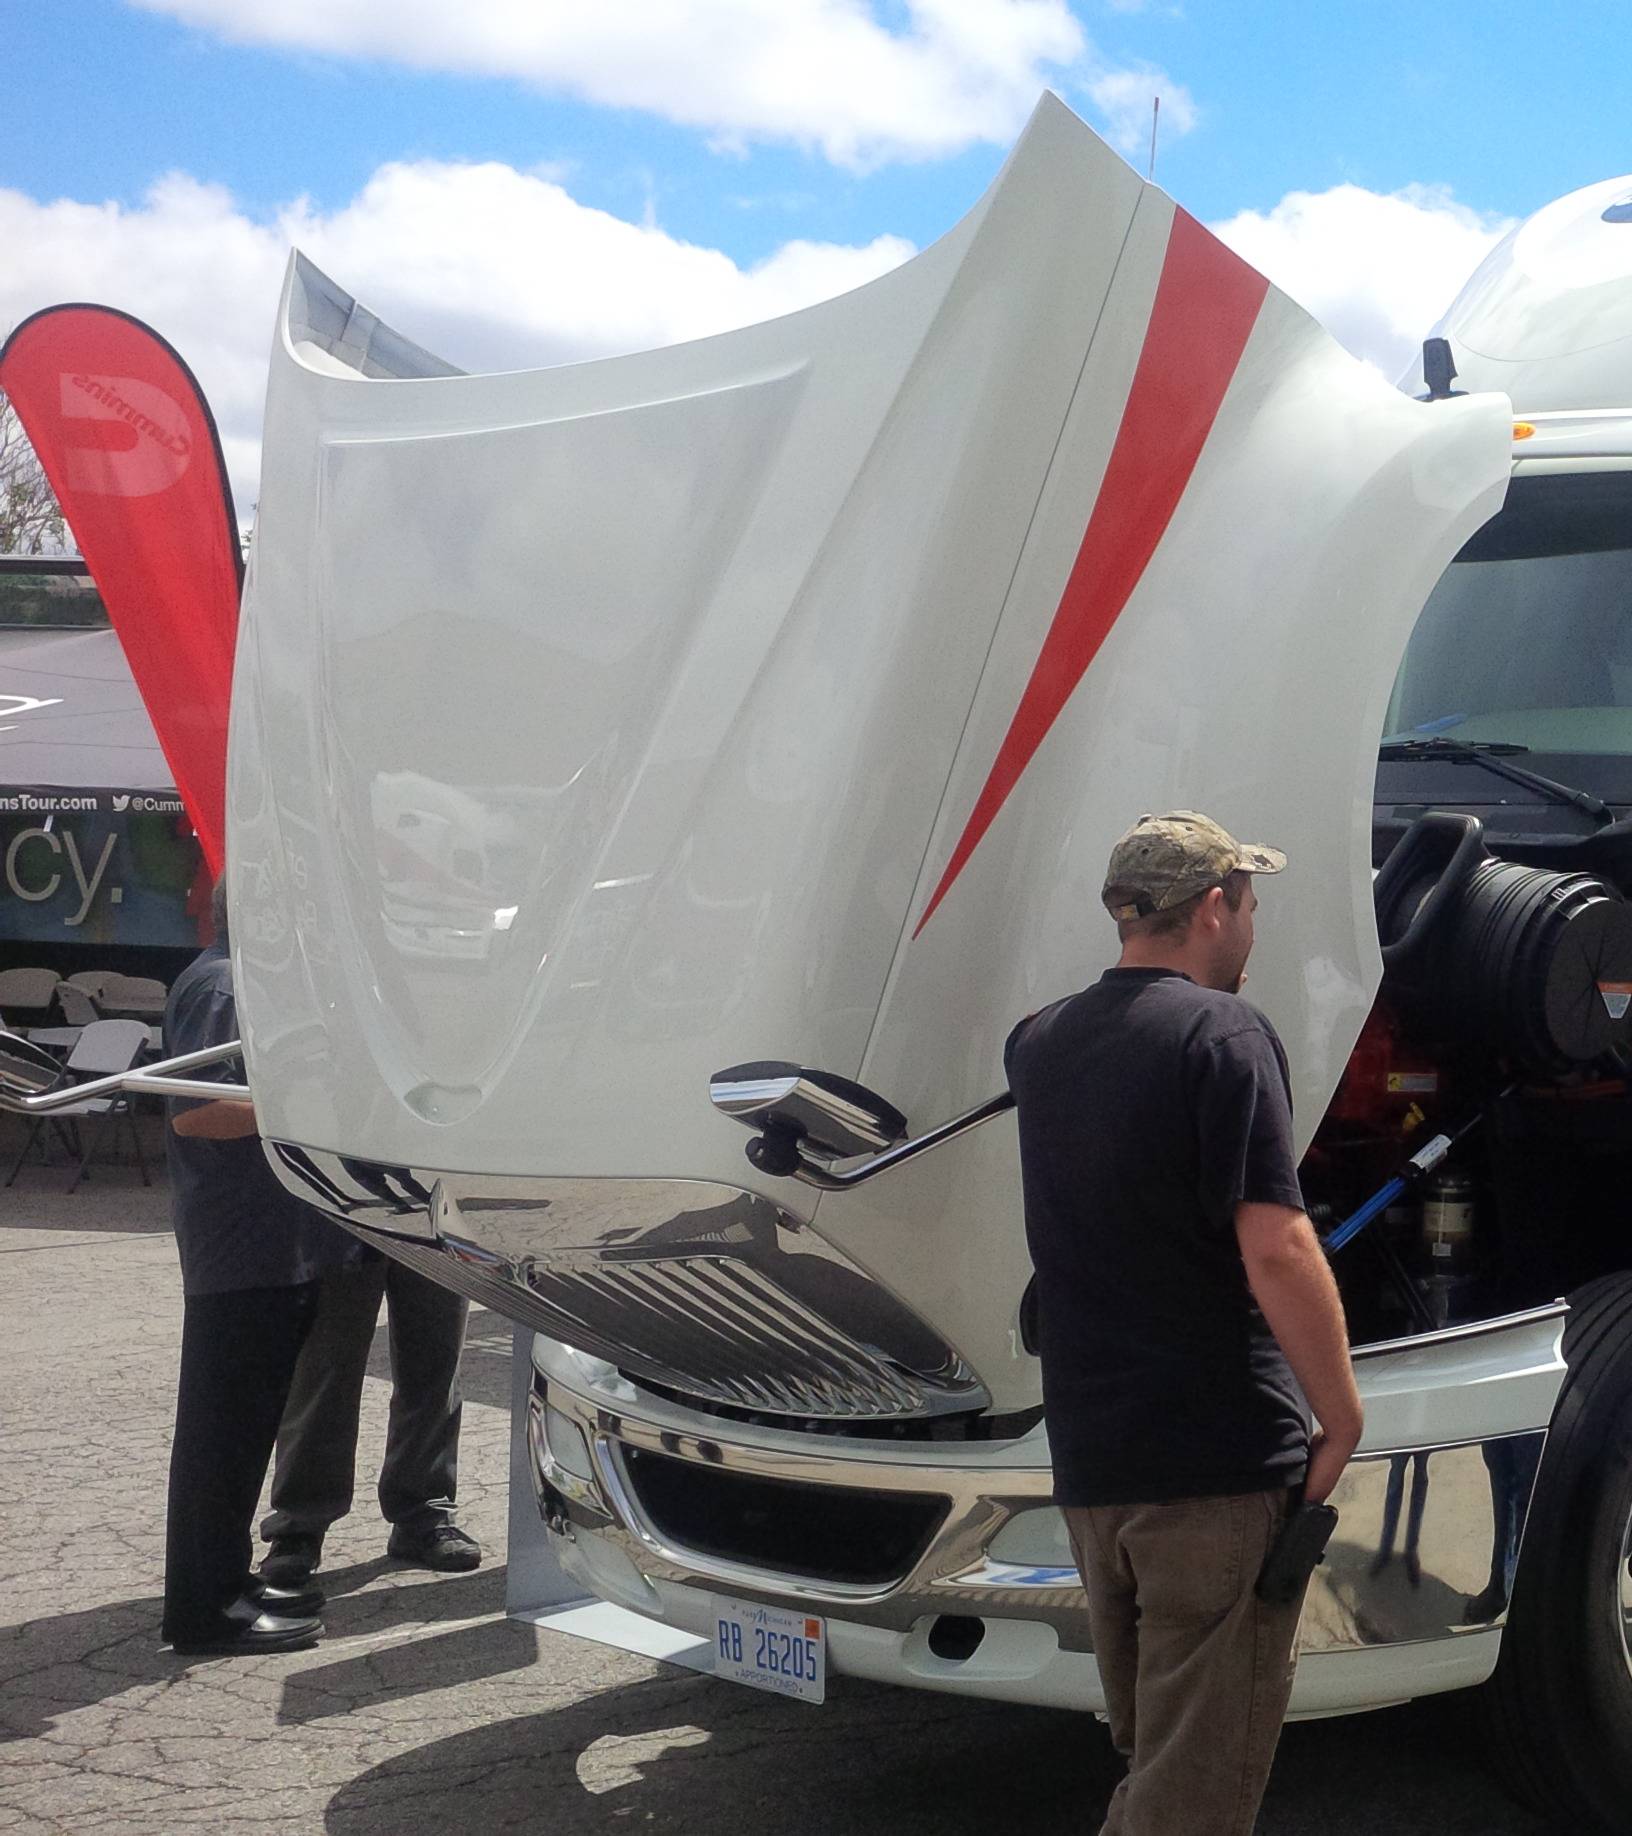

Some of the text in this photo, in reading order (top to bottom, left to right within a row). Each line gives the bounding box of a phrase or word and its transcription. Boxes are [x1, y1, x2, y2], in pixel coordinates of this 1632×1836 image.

[6, 827, 123, 926] cy.
[718, 1619, 816, 1682] RB 26205
[739, 1668, 799, 1693] APPORTIONED
